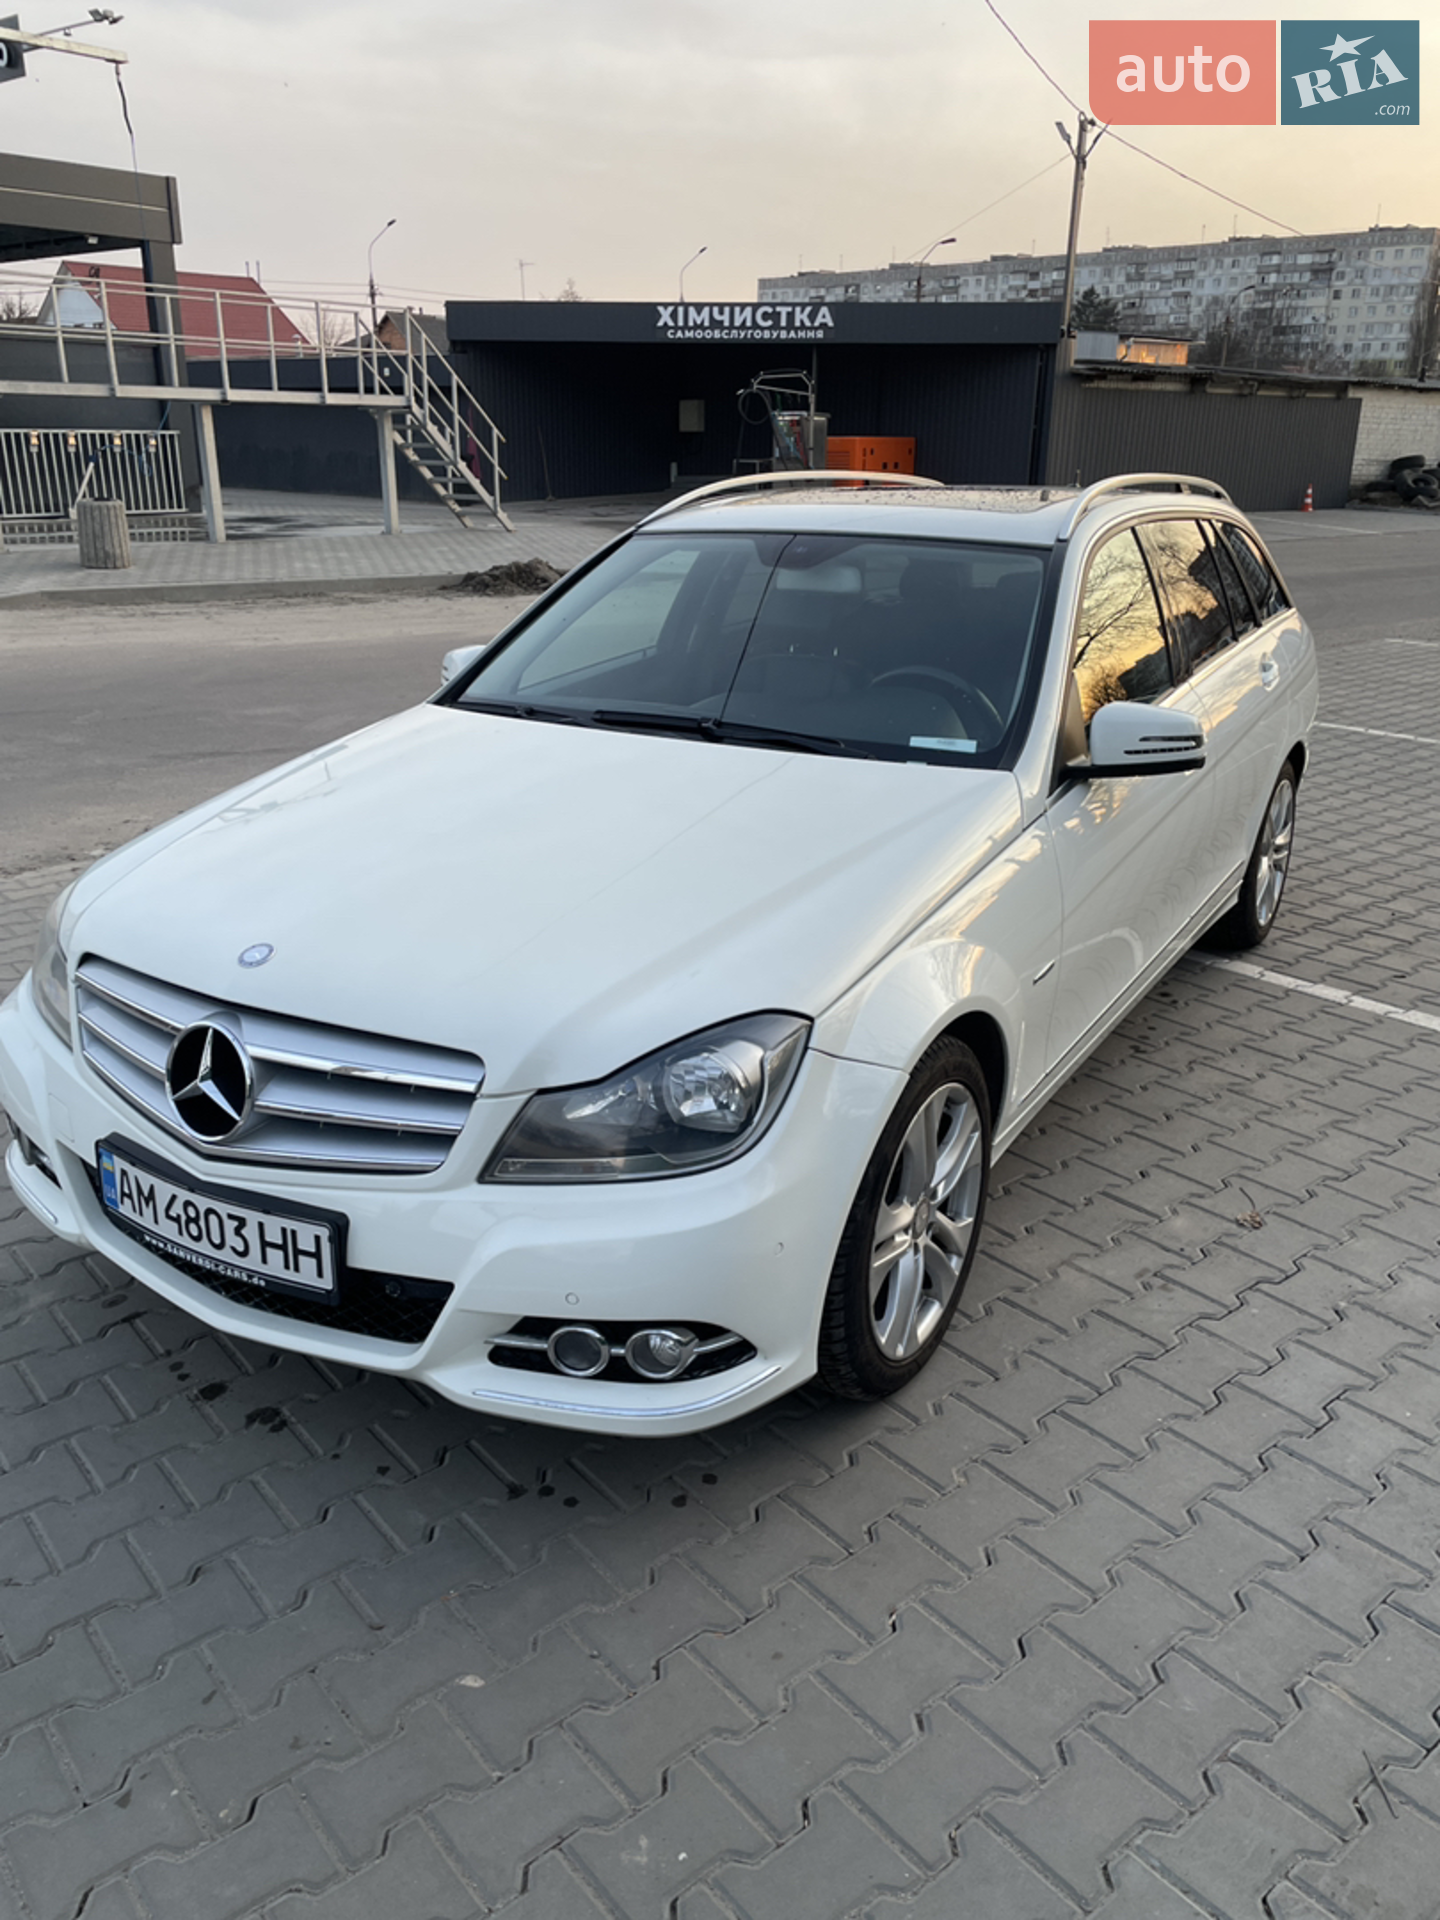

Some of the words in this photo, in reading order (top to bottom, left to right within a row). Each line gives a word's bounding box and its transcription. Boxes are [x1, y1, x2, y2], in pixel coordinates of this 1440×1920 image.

[656, 305, 835, 328] ХІМЧИСТКА
[667, 329, 825, 340] САМООБСЛУГОВУВАННЯ
[119, 1167, 160, 1227] AM
[164, 1194, 250, 1259] 4803
[257, 1220, 324, 1279] HH
